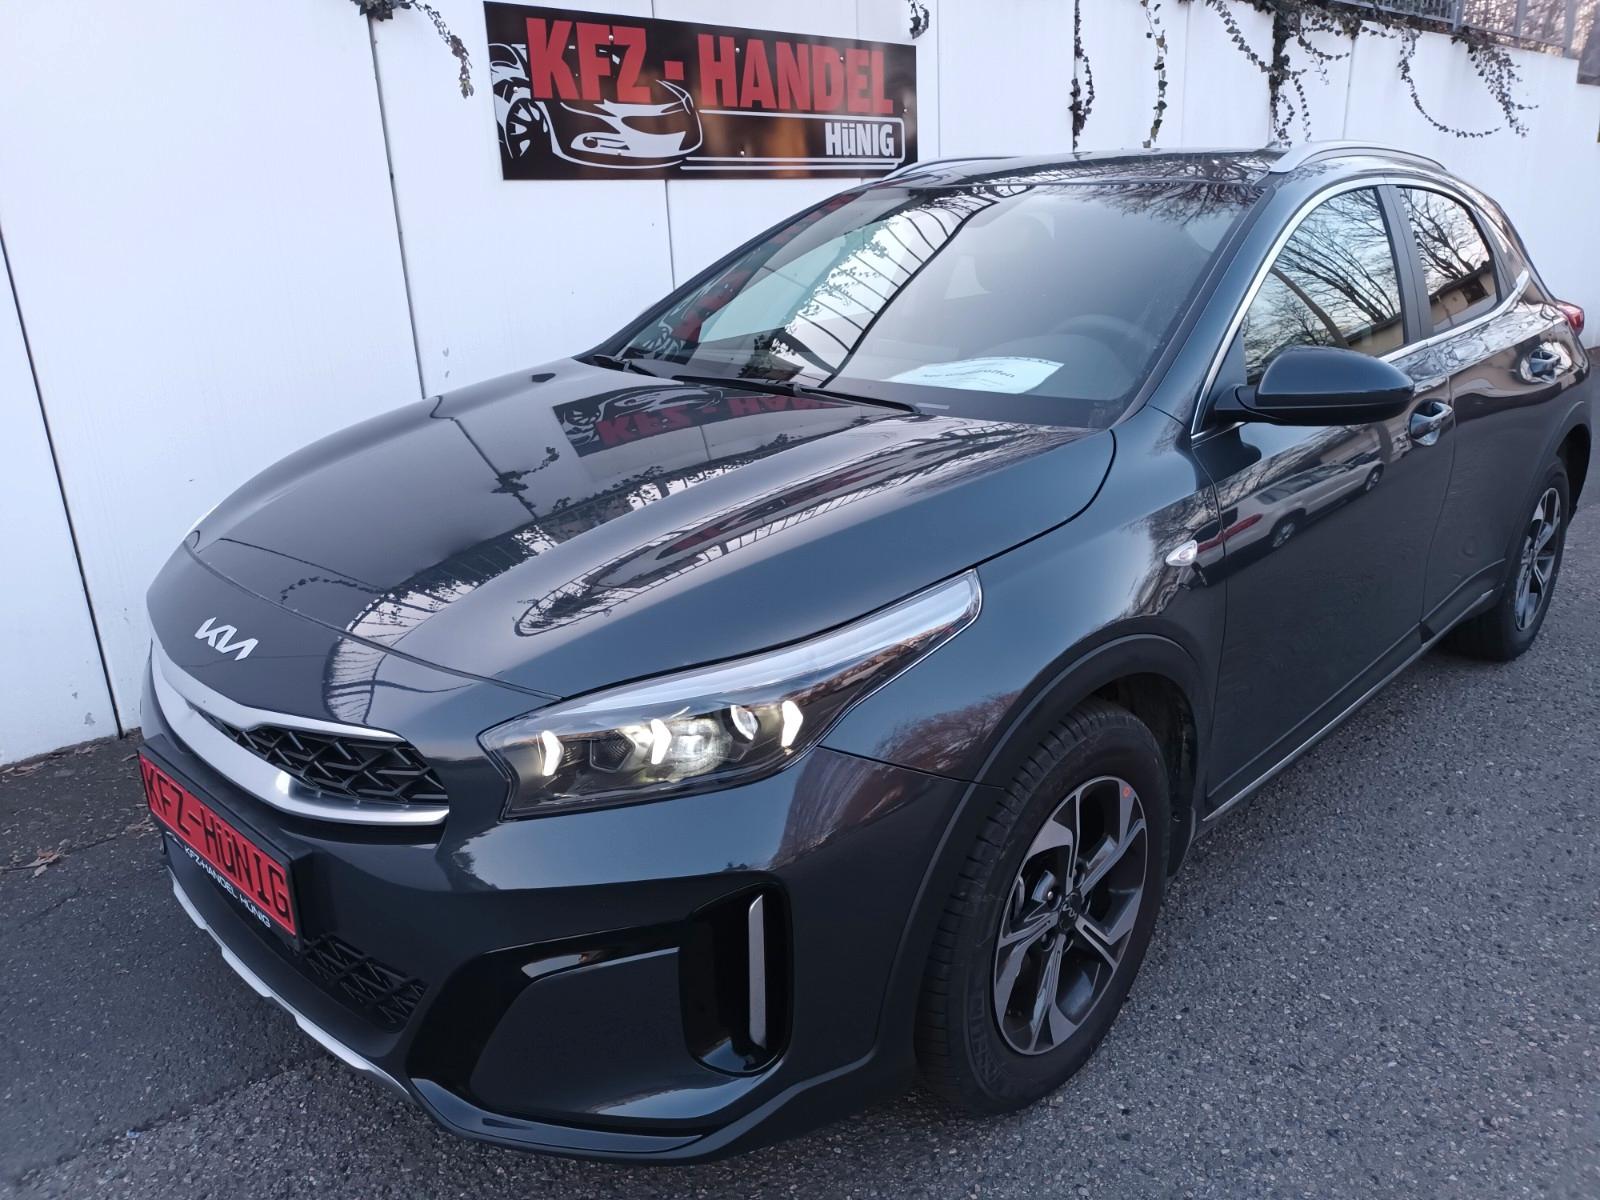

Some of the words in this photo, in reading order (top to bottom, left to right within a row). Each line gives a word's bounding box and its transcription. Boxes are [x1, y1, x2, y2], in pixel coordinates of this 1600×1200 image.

[526, 17, 652, 101] KFZ
[697, 33, 894, 115] HANDEL
[194, 616, 259, 661] KIA
